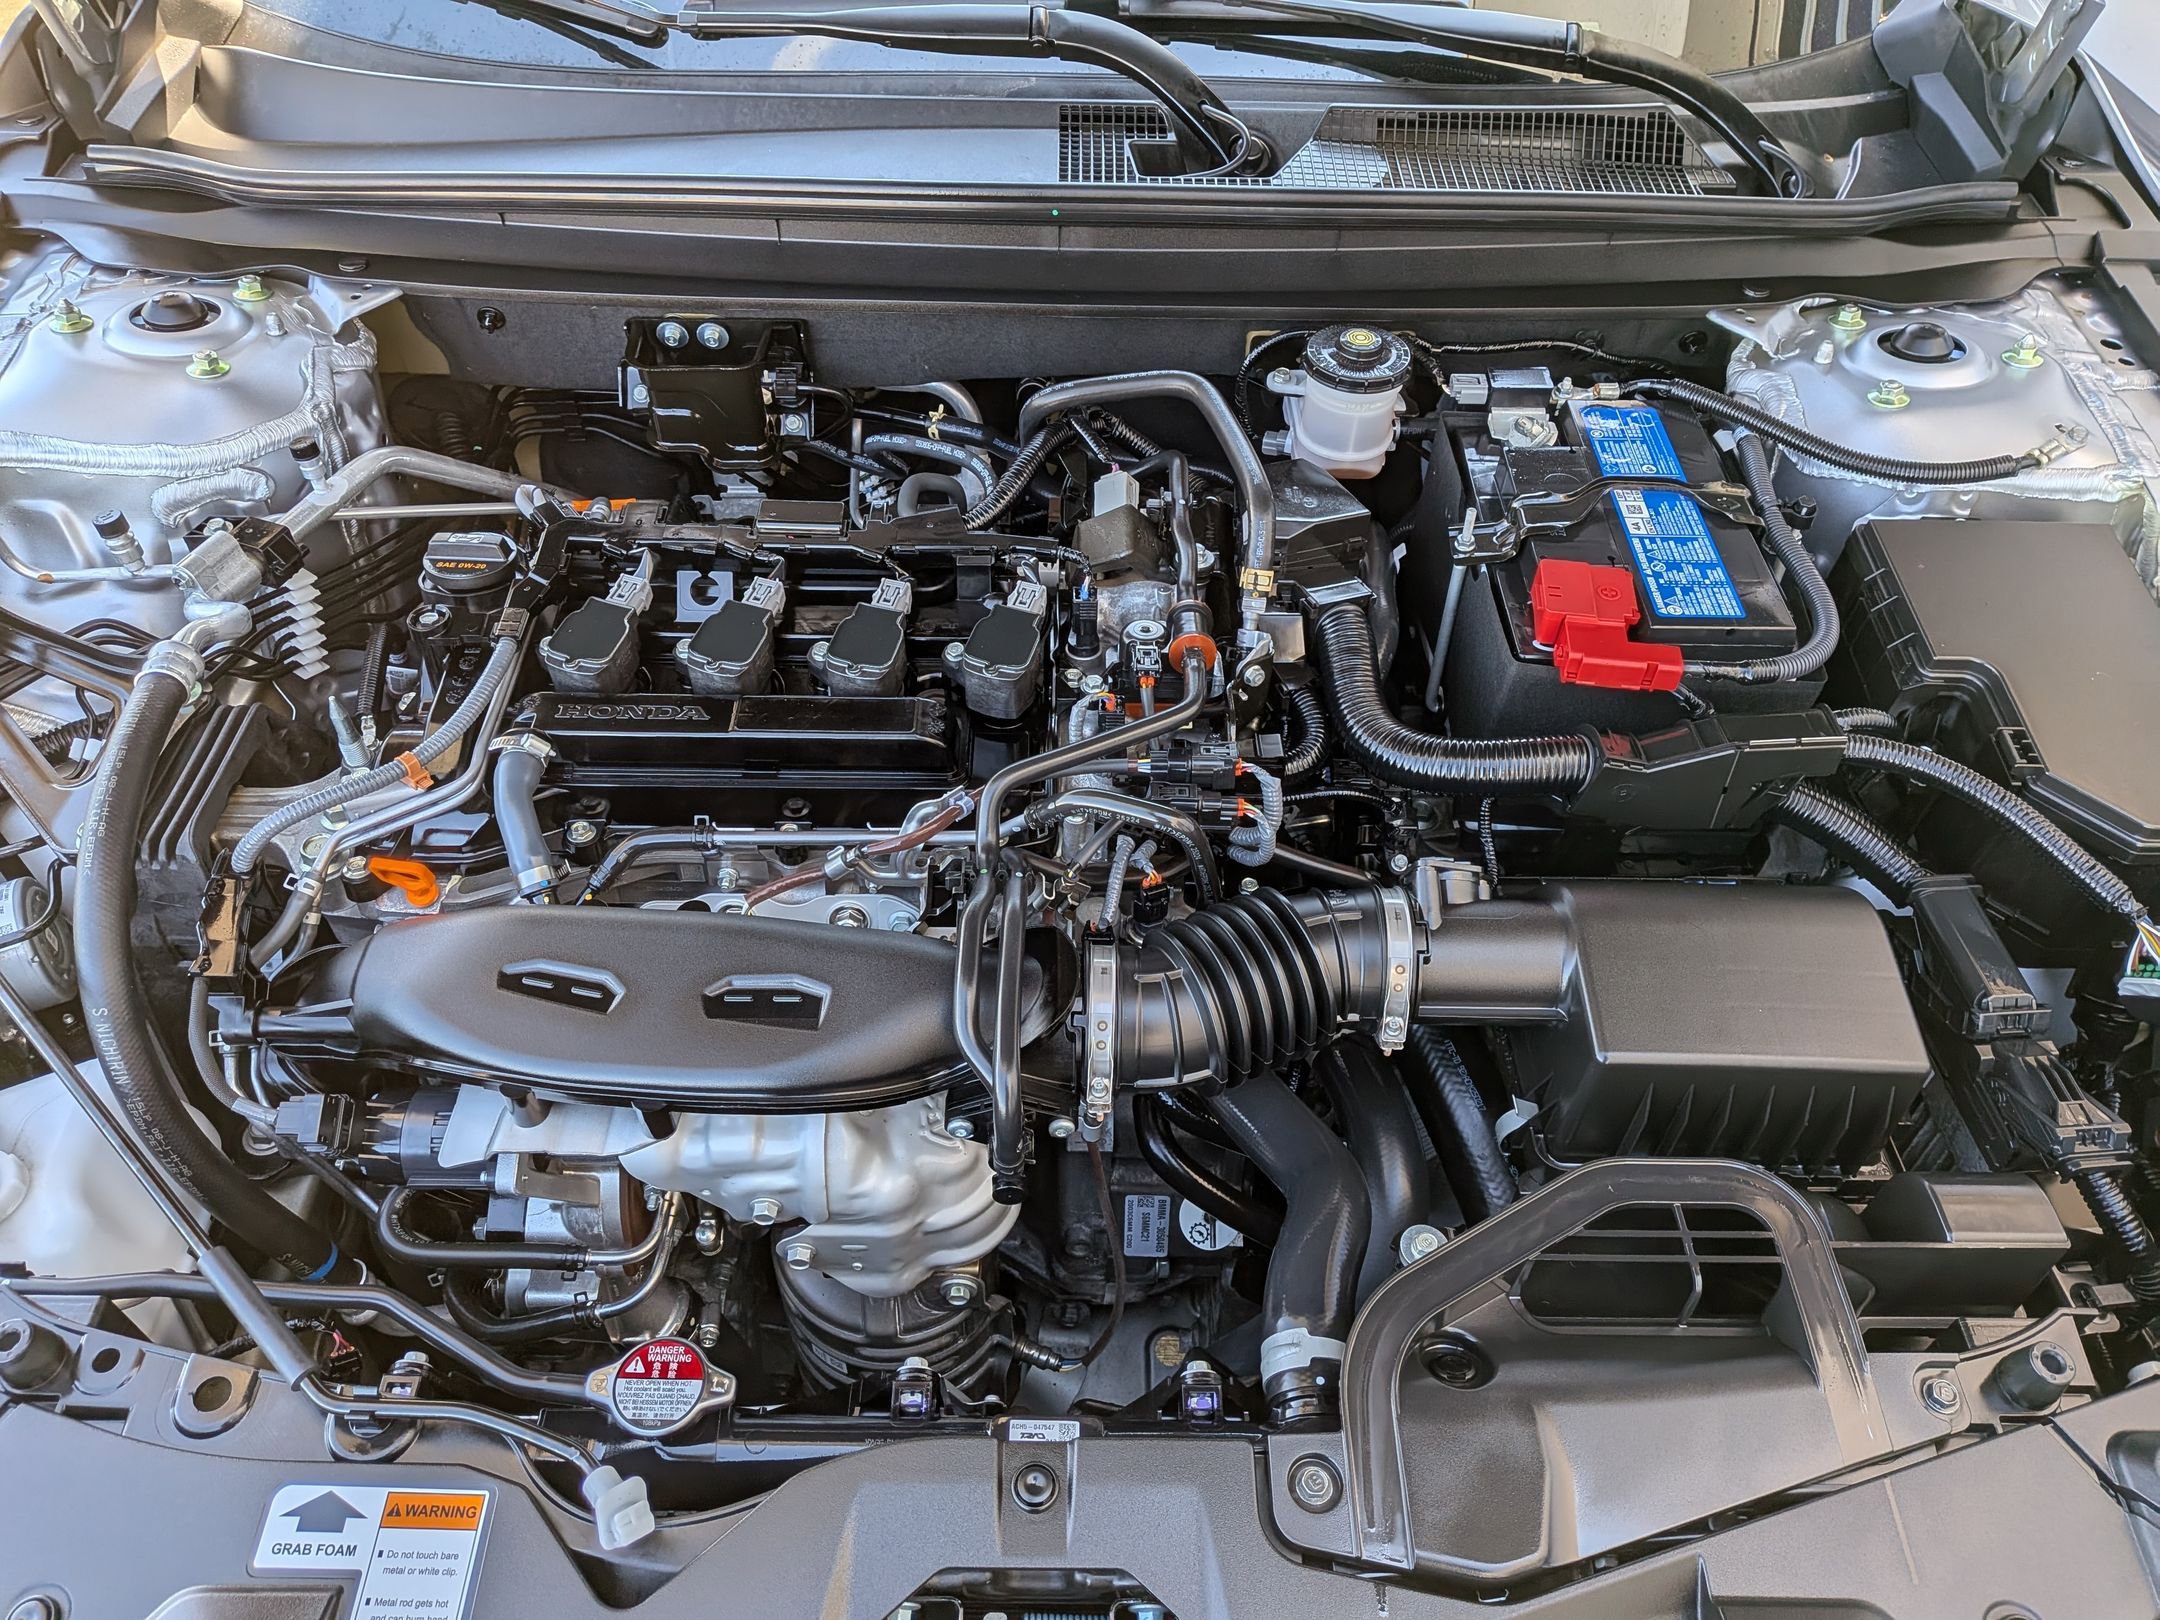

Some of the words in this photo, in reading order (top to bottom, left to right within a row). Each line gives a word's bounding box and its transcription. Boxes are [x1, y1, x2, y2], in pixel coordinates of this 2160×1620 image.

[554, 703, 711, 720] HONDA
[649, 1346, 685, 1354] DANGER
[647, 1354, 692, 1362] WARNUNG
[405, 1504, 477, 1519] WARNING
[271, 1543, 311, 1556] GRAB
[316, 1544, 357, 1557] FOAM
[387, 1550, 399, 1558] Do
[400, 1551, 415, 1559] not
[416, 1551, 439, 1560] touch
[440, 1552, 459, 1560] bare
[382, 1566, 406, 1575] metal
[418, 1566, 440, 1576] white
[441, 1567, 458, 1578] clip.
[374, 1597, 398, 1607] Metal
[399, 1598, 414, 1608] rod
[415, 1599, 433, 1609] gets
[435, 1599, 449, 1608] hot
